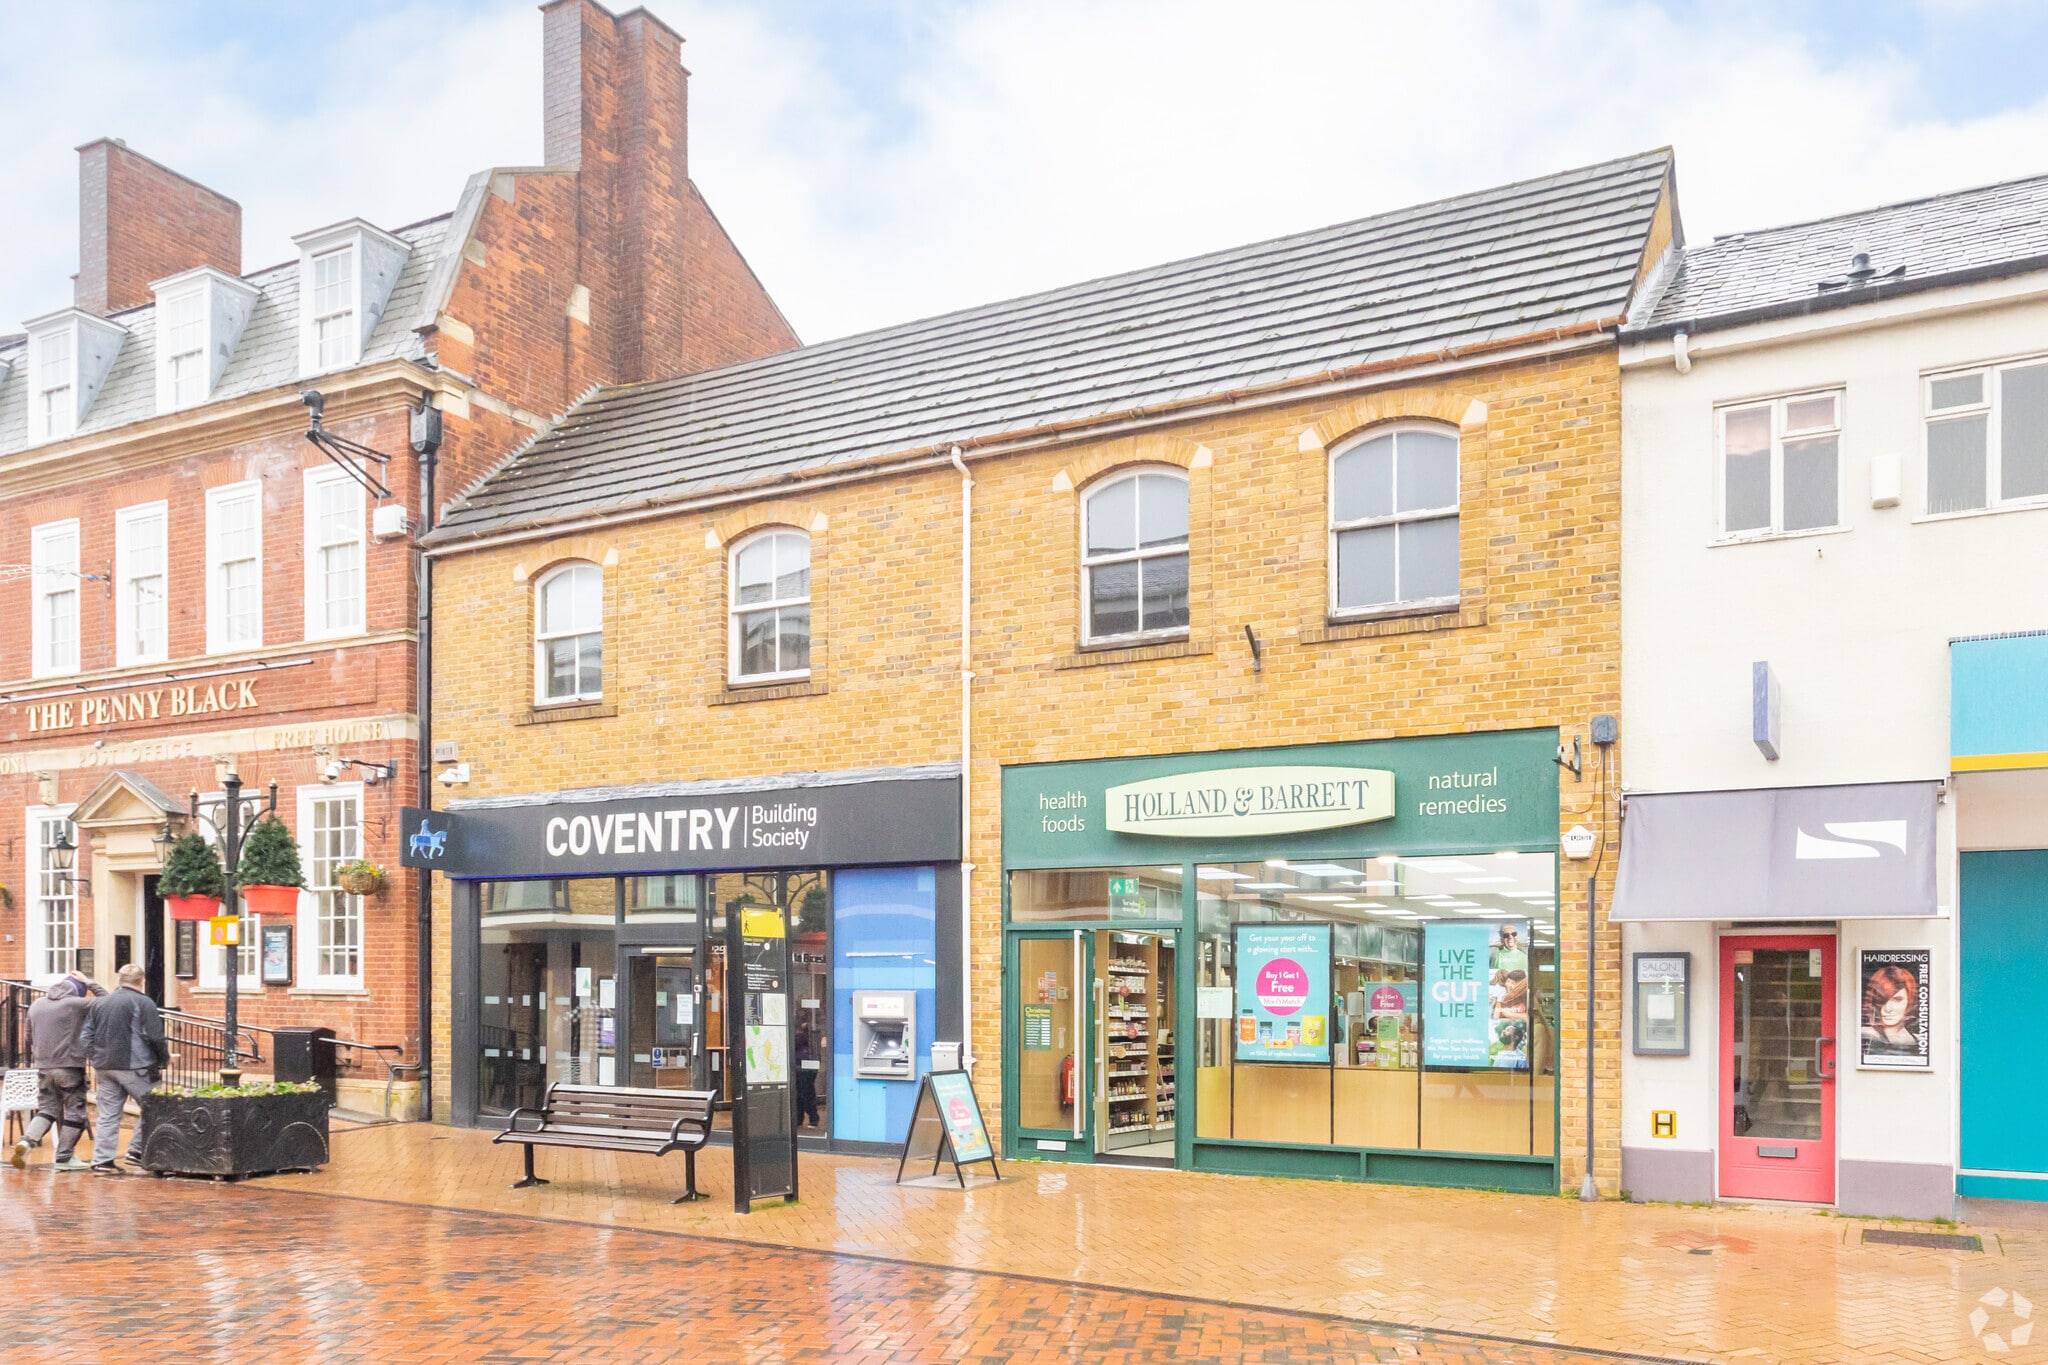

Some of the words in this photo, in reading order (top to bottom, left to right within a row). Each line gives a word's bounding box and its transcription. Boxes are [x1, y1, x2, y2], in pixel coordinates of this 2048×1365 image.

[25, 702, 74, 732] THE
[80, 689, 164, 727] PENNY
[169, 677, 259, 717] BLACK
[274, 730, 317, 748] FREE
[324, 721, 384, 744] HOUSE
[80, 749, 118, 768] POST
[131, 742, 194, 763] OFFICE
[1429, 766, 1497, 790] natural
[1039, 791, 1087, 810] health
[1124, 788, 1227, 822] HOLLAND
[1233, 787, 1253, 816] &
[1261, 780, 1369, 810] BARRETT
[1419, 794, 1507, 816] remedies
[752, 803, 817, 826] Building
[1041, 814, 1085, 833] foods
[546, 806, 739, 856] COVENTRY
[752, 827, 810, 850] Society
[1250, 933, 1262, 942] Get
[1264, 936, 1279, 944] your
[1280, 935, 1295, 944] year
[1297, 933, 1307, 942] off
[1308, 934, 1316, 942] to
[1253, 946, 1278, 955] glowing
[1280, 945, 1296, 953] start
[1439, 949, 1475, 964] LIVE
[1864, 954, 1928, 962] HAIRDRESSING
[1265, 971, 1278, 980] Buy
[1283, 971, 1295, 979] Get
[1440, 965, 1473, 980] THE
[1642, 962, 1677, 972] SALON
[1919, 964, 1928, 984] FREE
[1271, 981, 1294, 993] Free
[1431, 981, 1482, 1003] GUT
[1440, 1003, 1474, 1018] LIFE
[1919, 987, 1928, 1055] CONSULTATION
[1655, 1113, 1672, 1135] H
